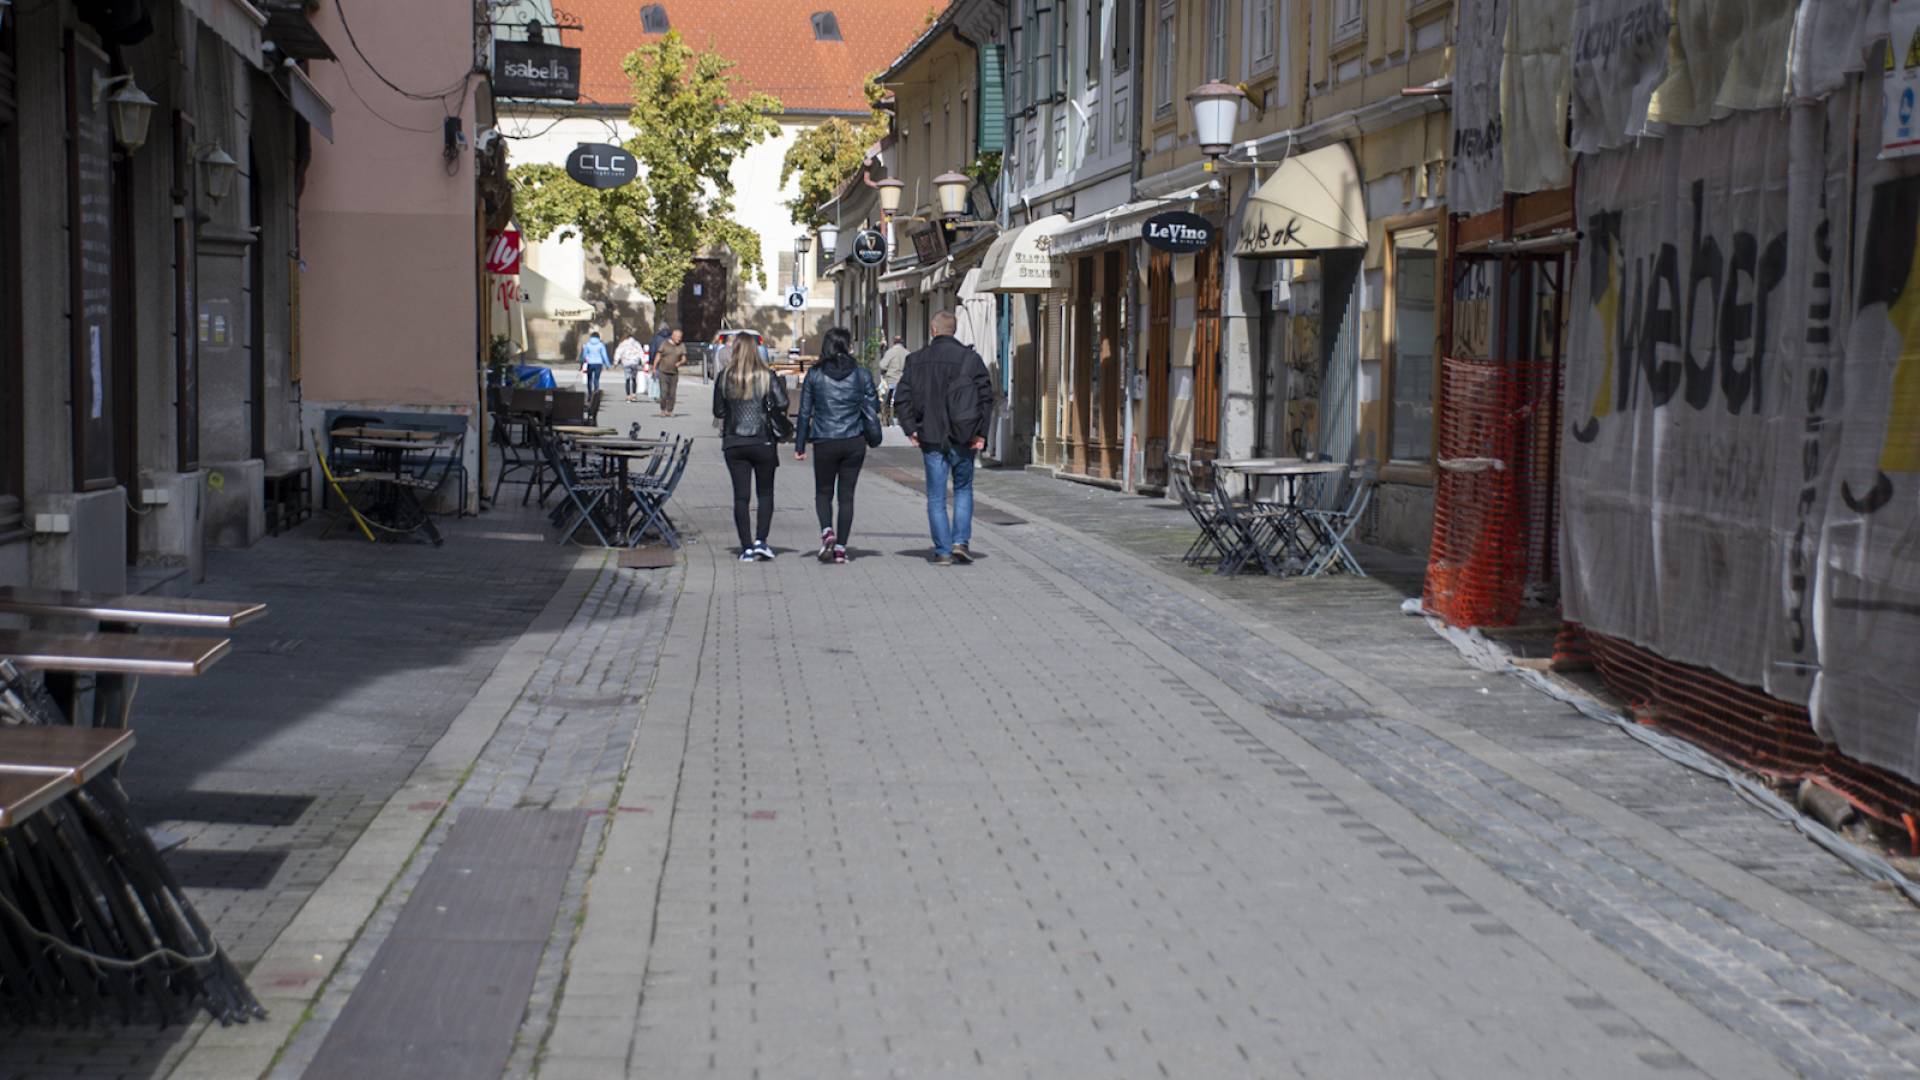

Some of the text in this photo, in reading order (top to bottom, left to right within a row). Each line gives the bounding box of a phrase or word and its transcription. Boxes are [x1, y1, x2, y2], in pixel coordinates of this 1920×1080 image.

[504, 59, 569, 80] isabella
[580, 154, 625, 171] CLC
[1150, 222, 1207, 243] LeVino
[1616, 179, 1788, 415] weber
